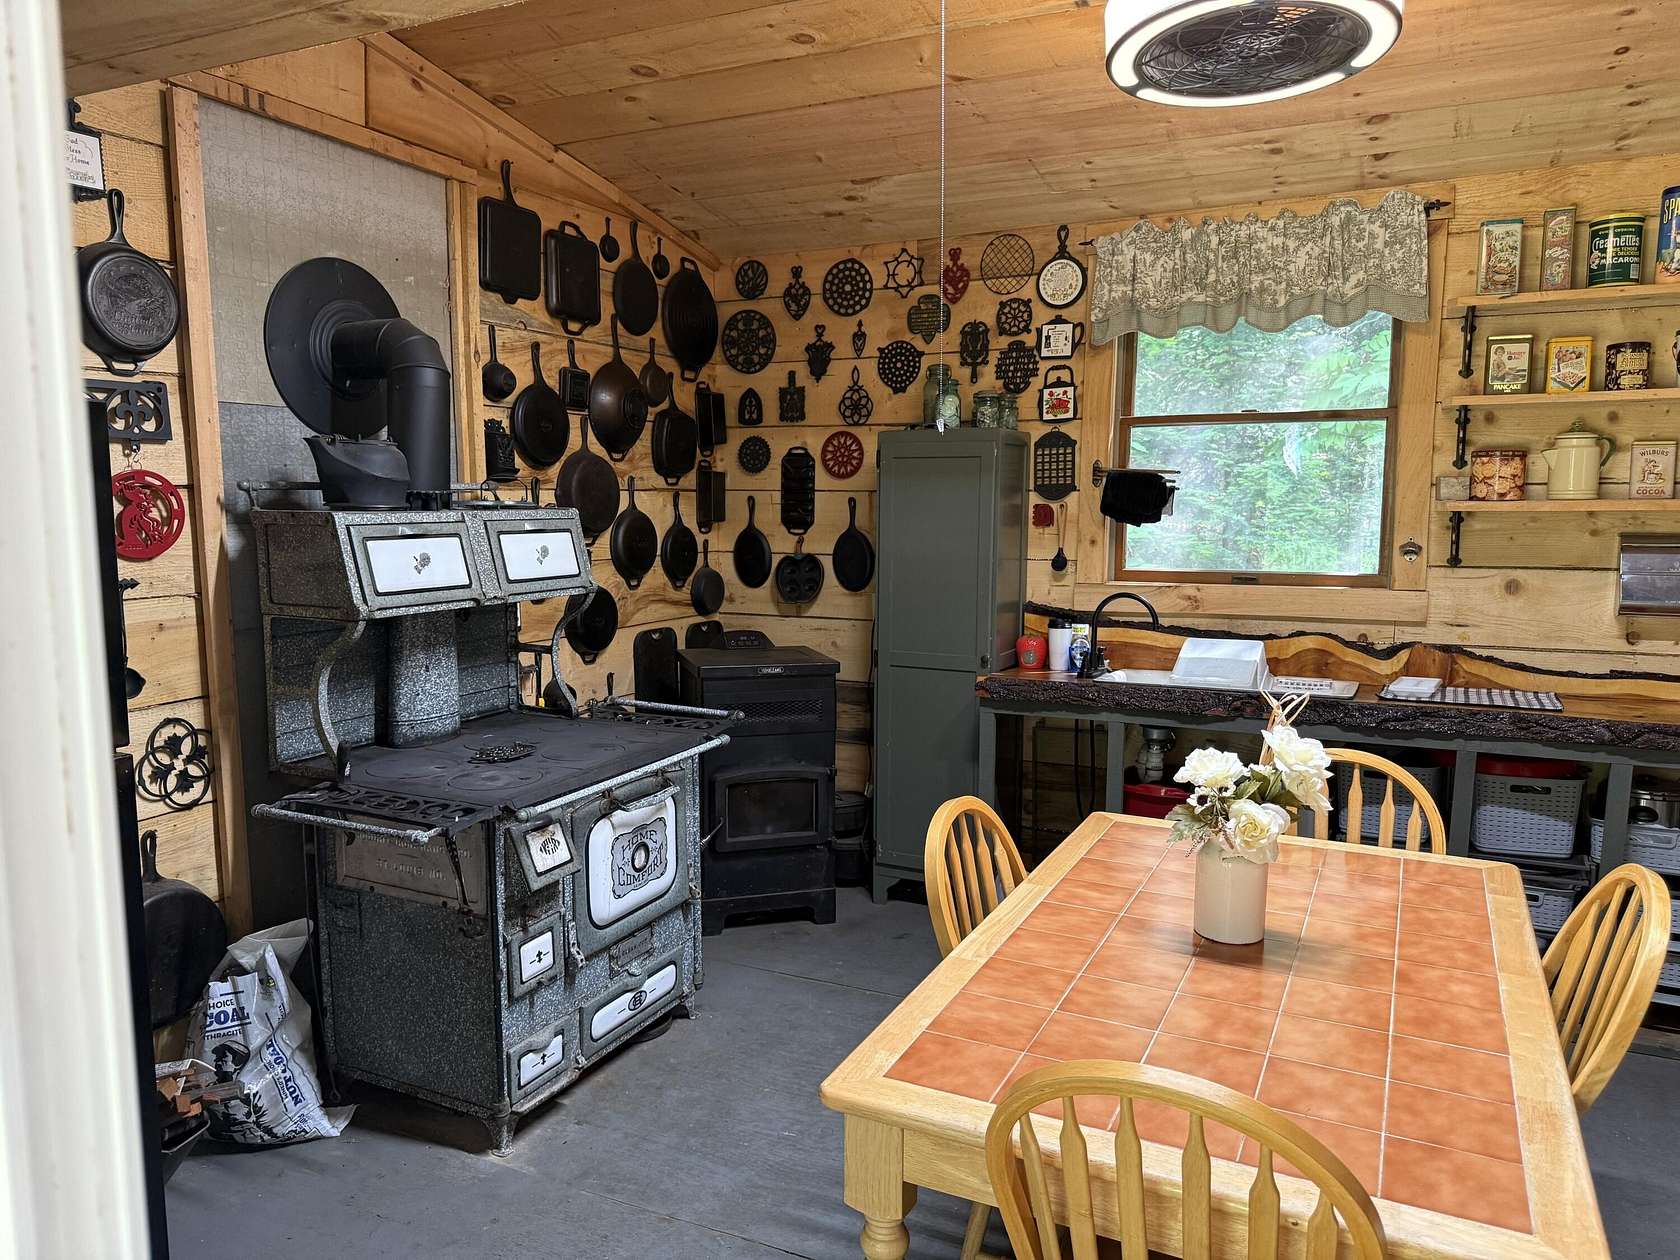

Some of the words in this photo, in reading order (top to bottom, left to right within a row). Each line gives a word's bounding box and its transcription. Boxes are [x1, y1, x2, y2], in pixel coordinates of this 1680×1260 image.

[1636, 488, 1665, 496] COCOA
[621, 829, 658, 861] HOME
[617, 842, 664, 887] COMFORT
[208, 998, 235, 1011] HOICE
[283, 1074, 304, 1108] NUT
